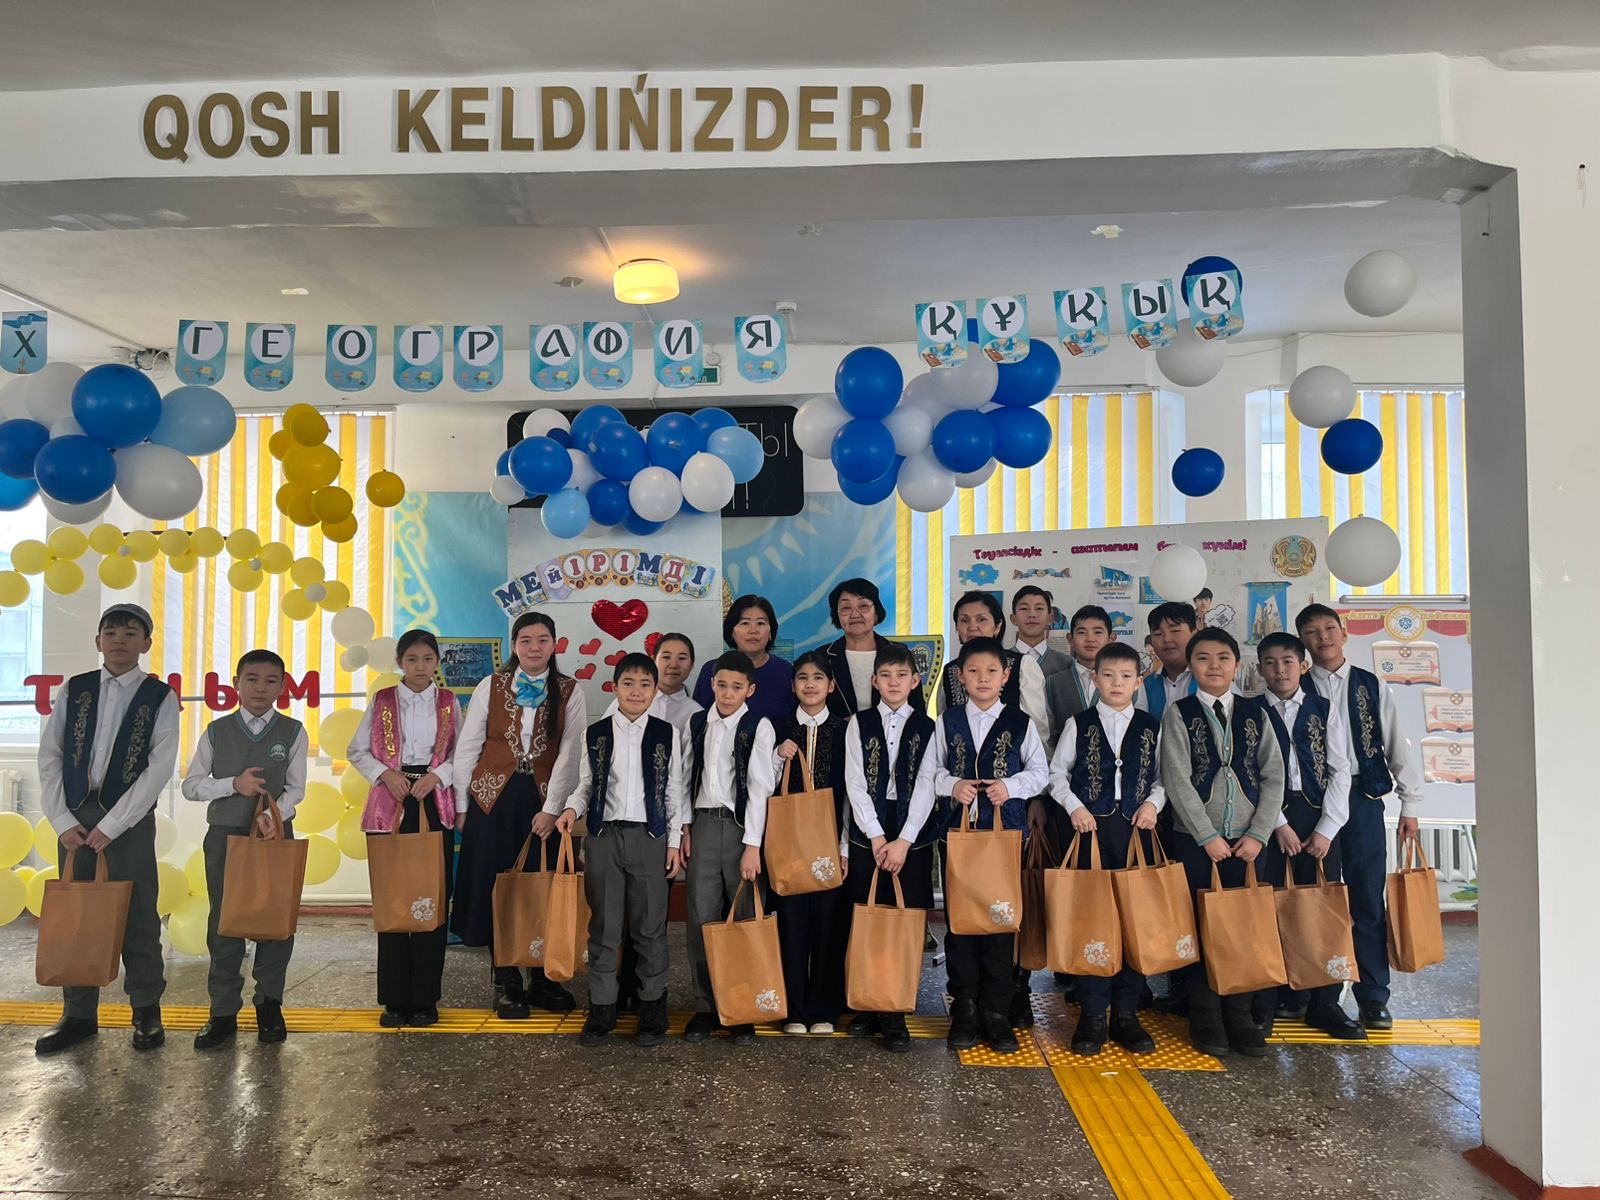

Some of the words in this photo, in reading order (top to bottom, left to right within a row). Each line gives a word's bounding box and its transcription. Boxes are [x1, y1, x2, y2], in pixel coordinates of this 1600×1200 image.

[141, 90, 341, 163] QOSH
[397, 73, 926, 153] KELDIŃIZDER!
[191, 319, 775, 360] ГЕОГРАФИЯ
